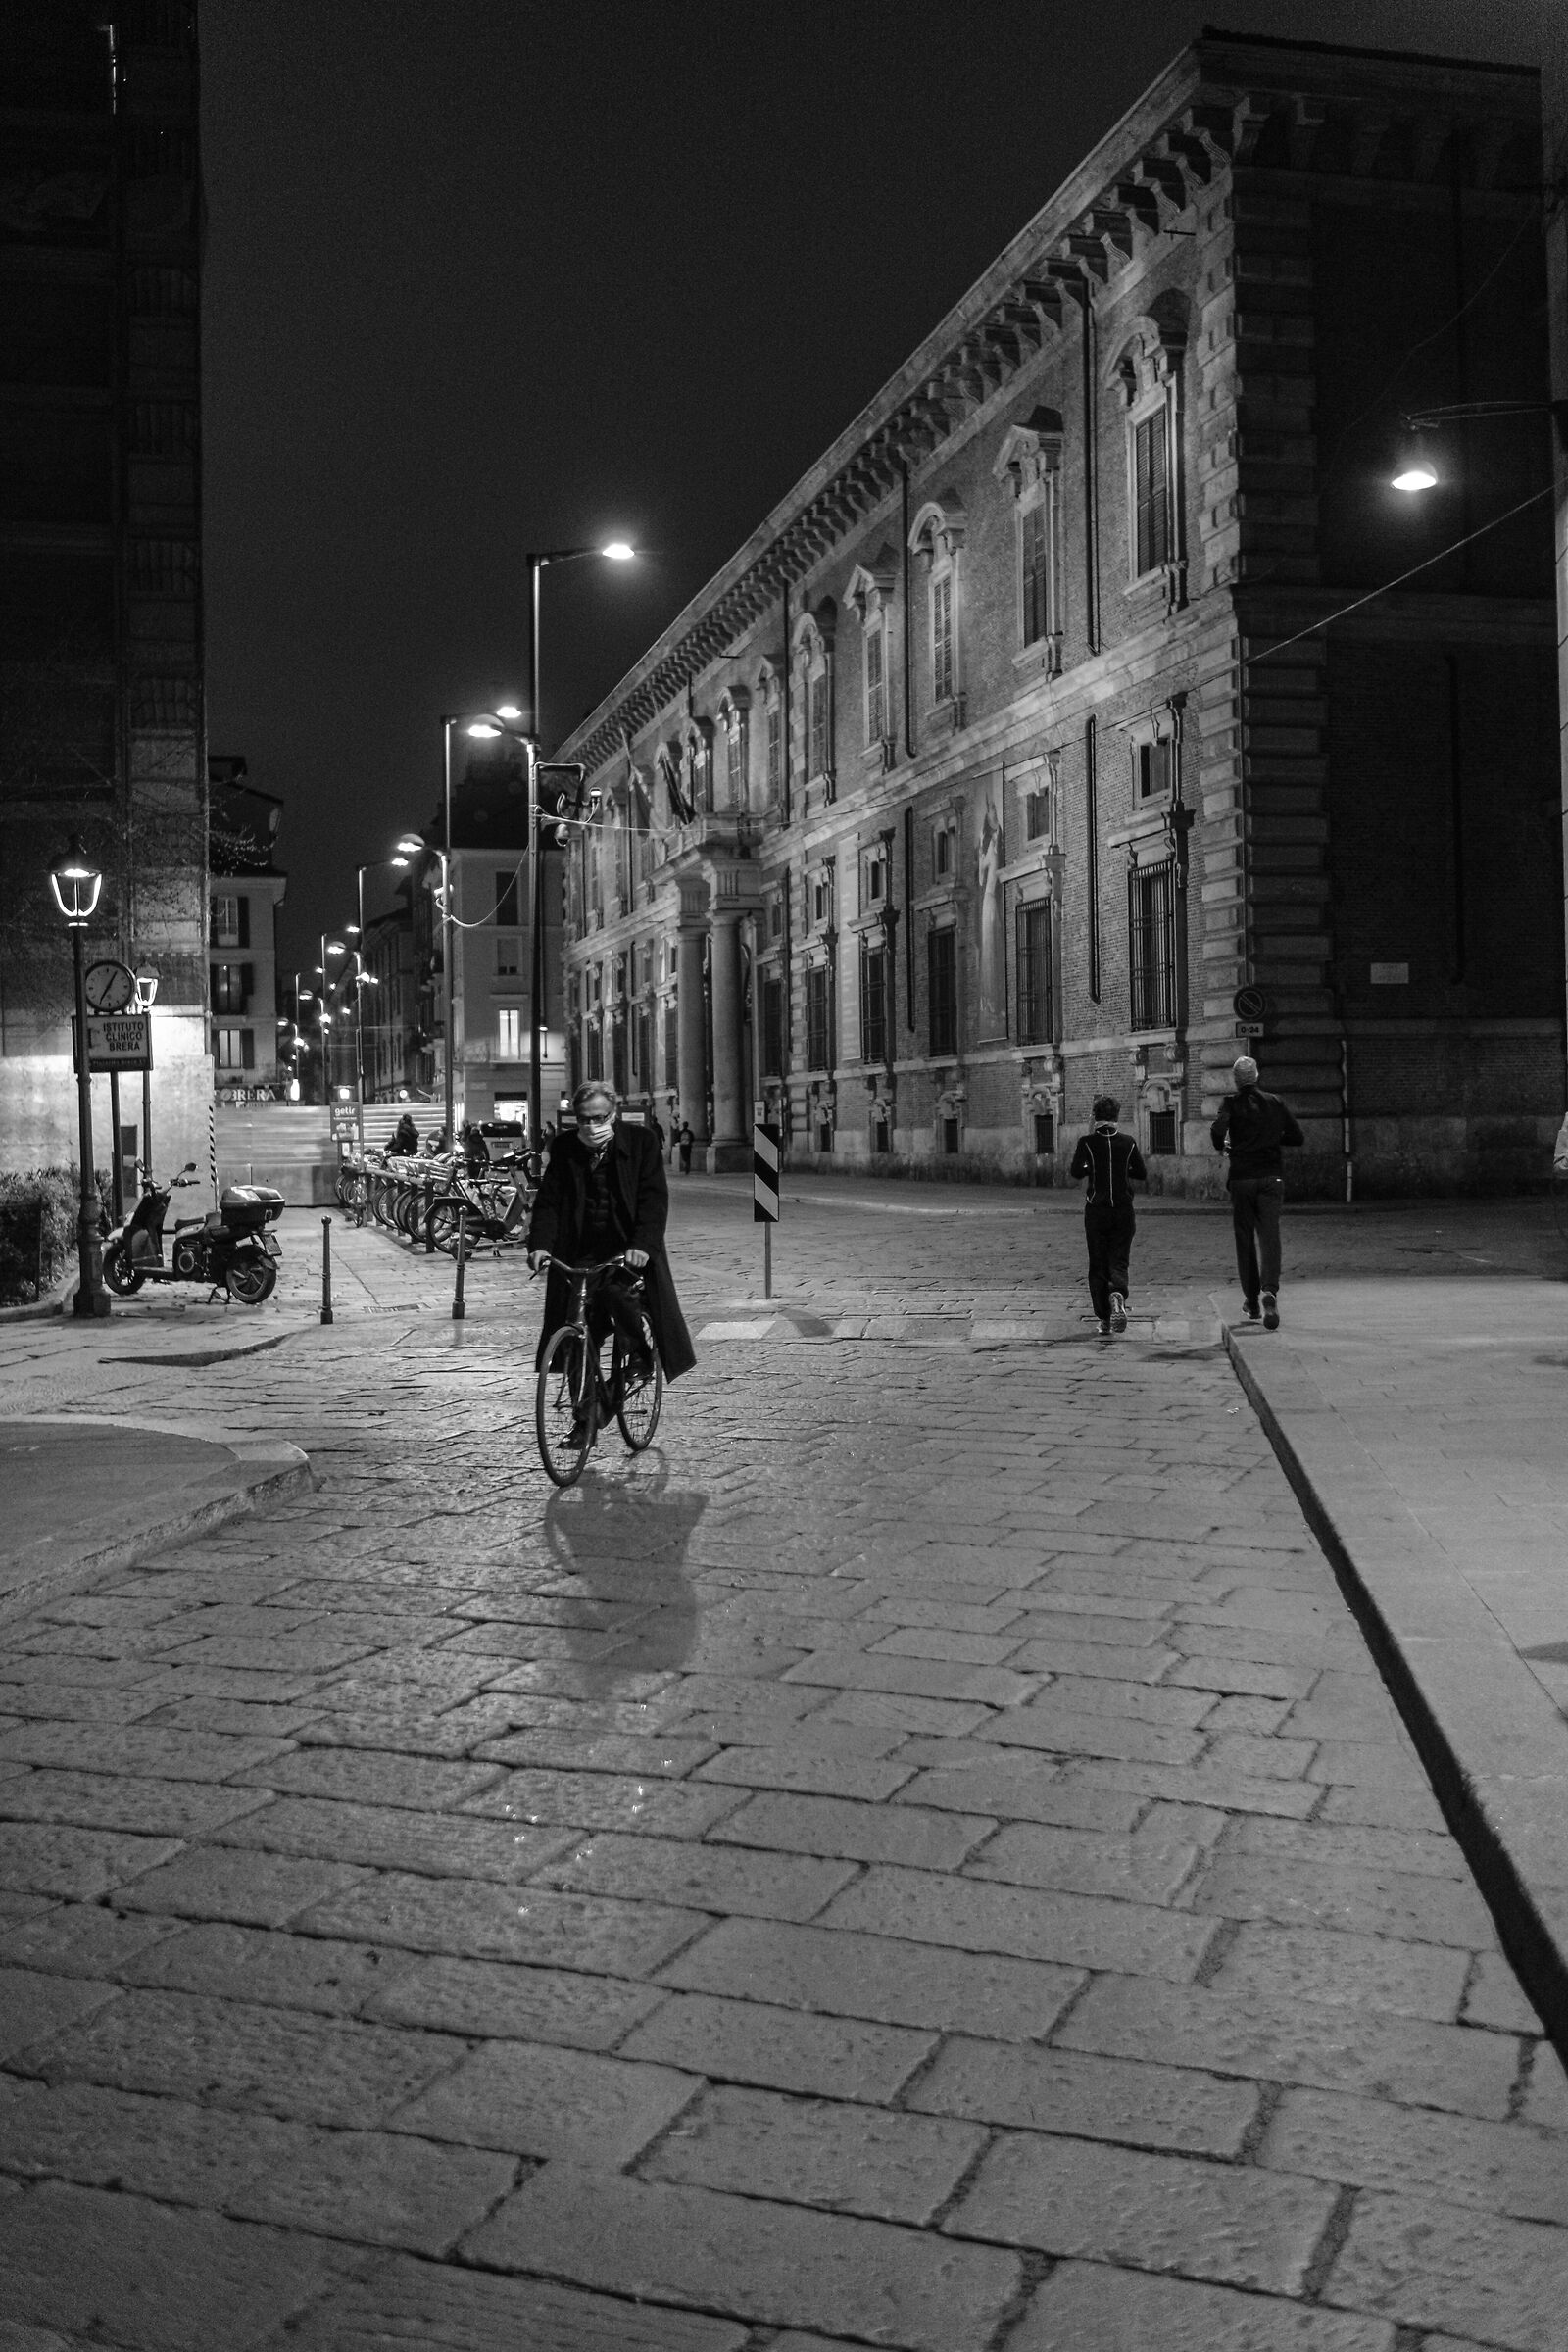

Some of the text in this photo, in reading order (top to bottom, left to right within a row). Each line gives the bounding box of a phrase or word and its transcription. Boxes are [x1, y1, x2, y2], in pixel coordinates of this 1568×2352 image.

[103, 1021, 144, 1032] ISTITUTO
[106, 1031, 142, 1042] CLINICO
[109, 1041, 140, 1052] BRERA
[334, 1105, 356, 1117] getir
